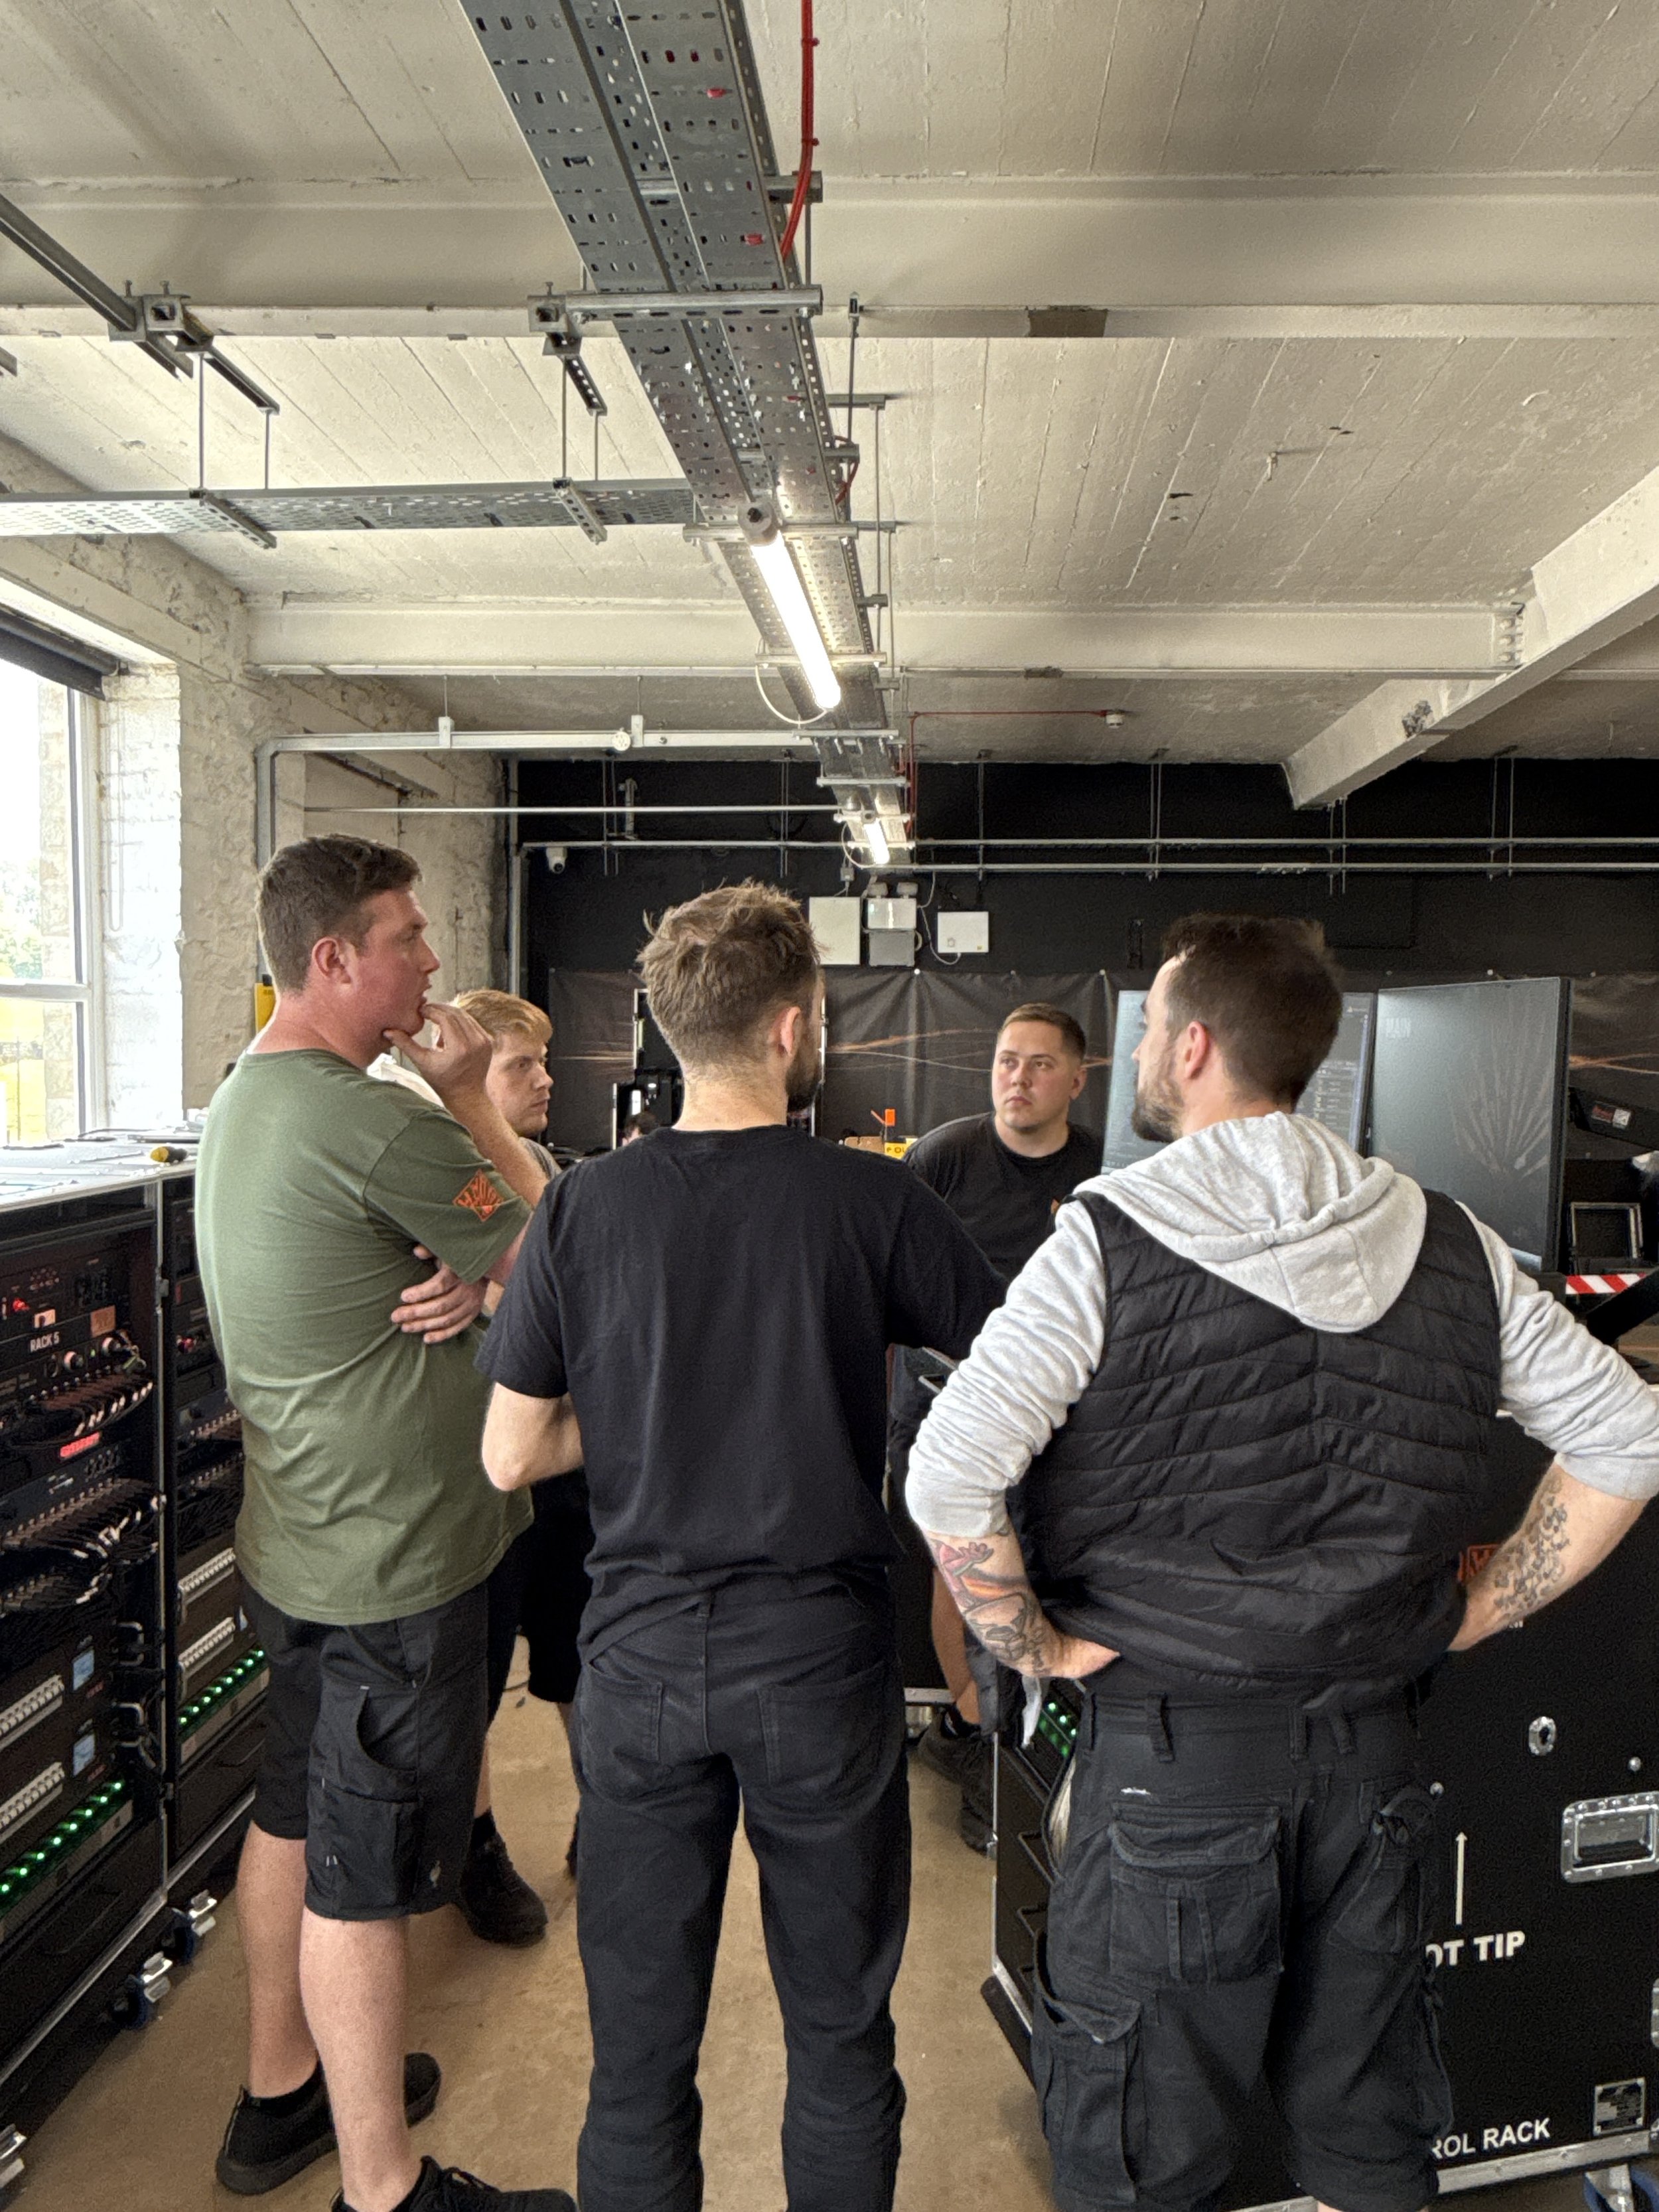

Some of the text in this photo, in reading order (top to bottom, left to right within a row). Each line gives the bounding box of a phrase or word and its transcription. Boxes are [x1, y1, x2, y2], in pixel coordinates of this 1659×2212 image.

[30, 1331, 60, 1353] RACK 5
[1473, 1931, 1526, 1961] TIP
[1483, 2117, 1550, 2150] RACK
